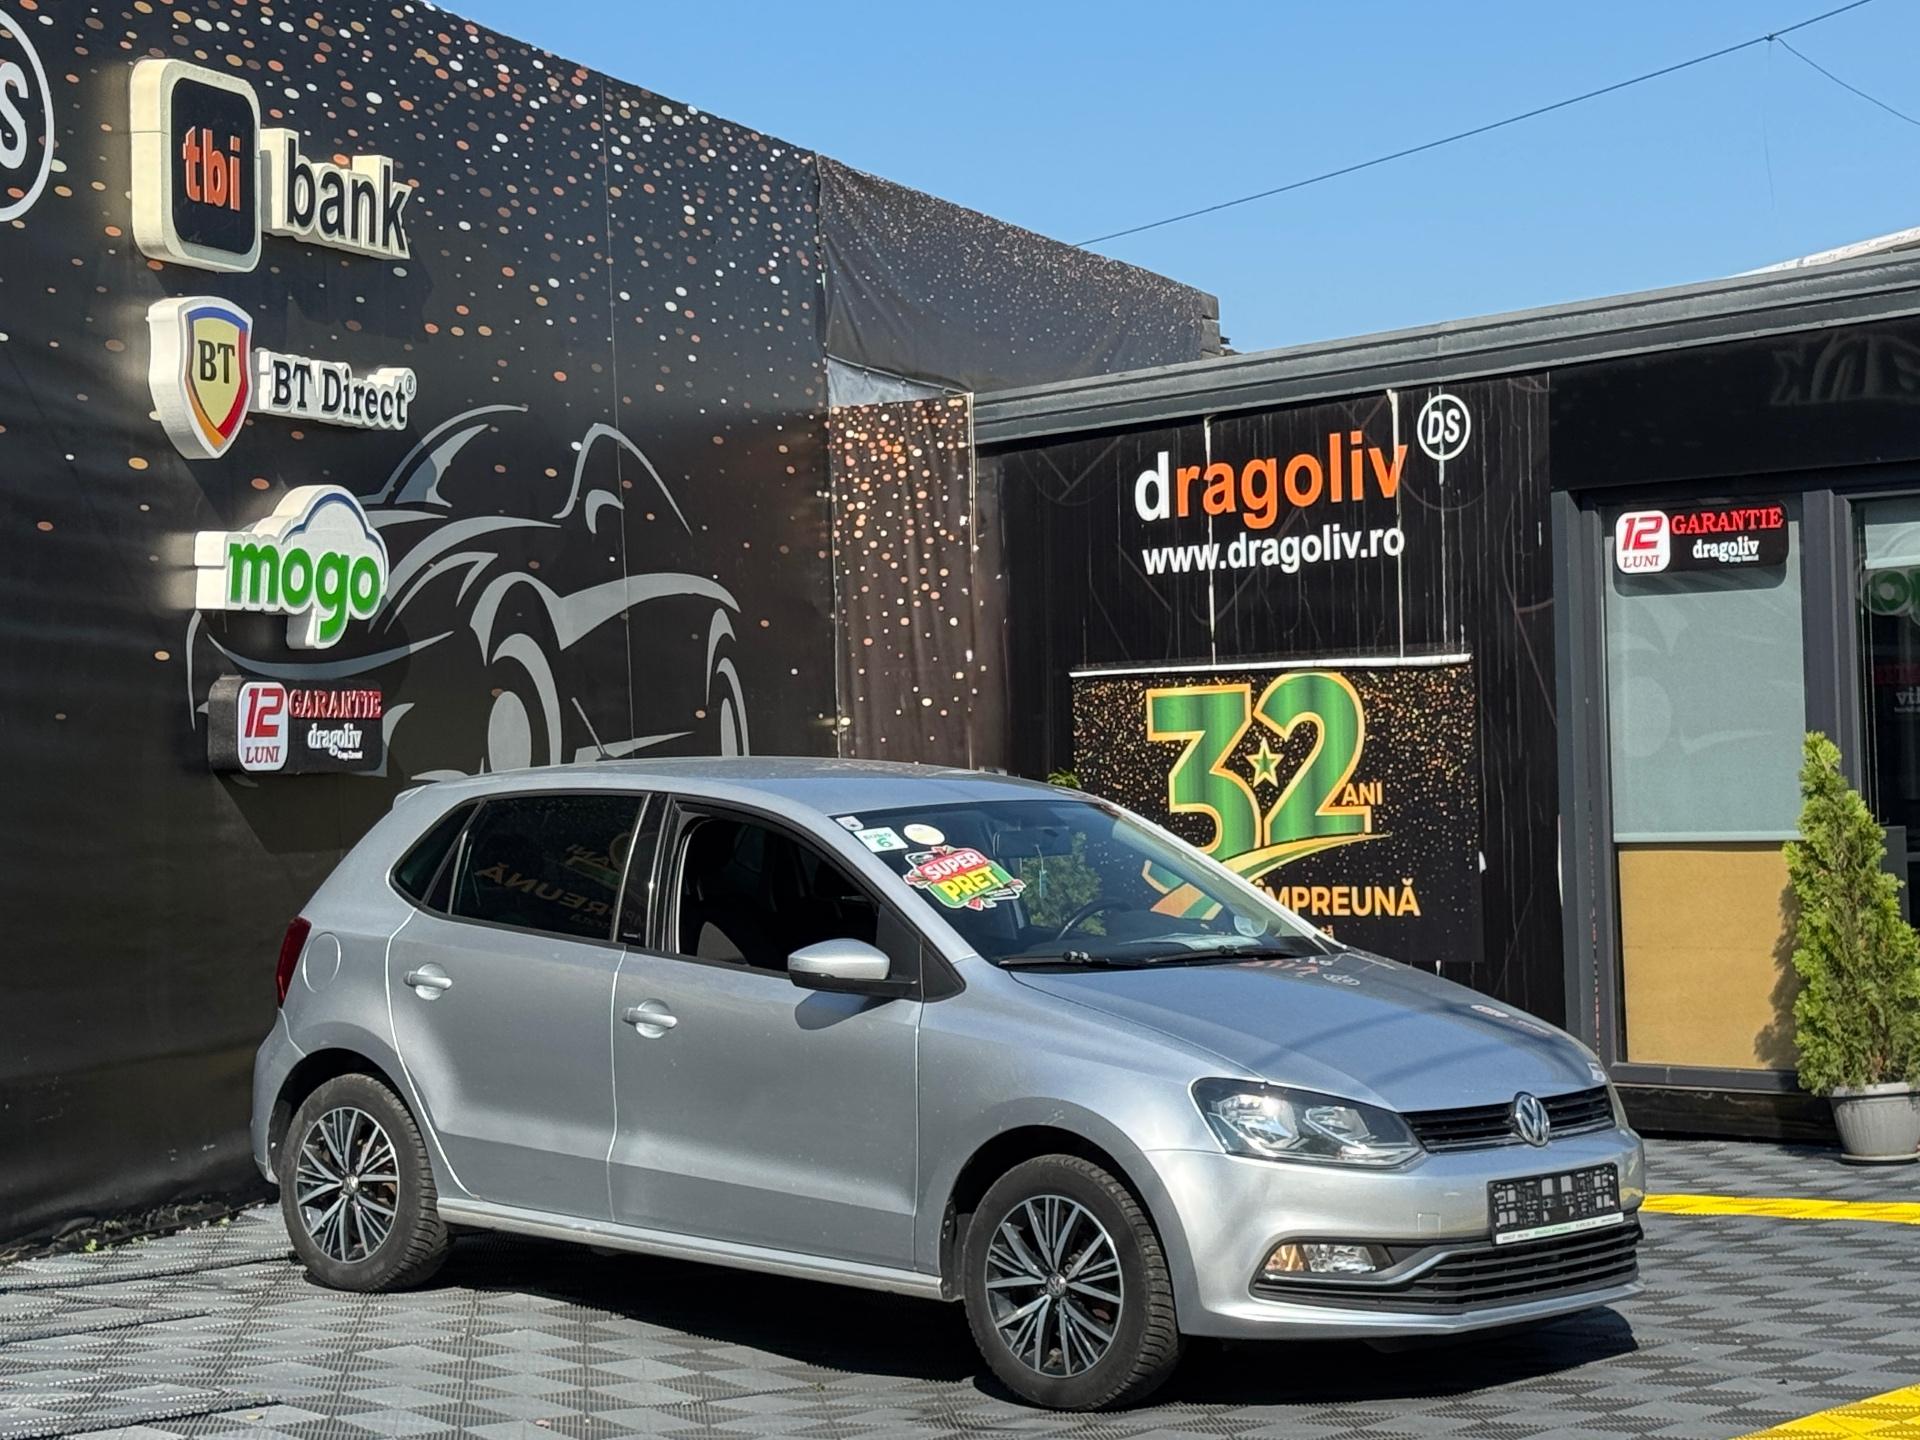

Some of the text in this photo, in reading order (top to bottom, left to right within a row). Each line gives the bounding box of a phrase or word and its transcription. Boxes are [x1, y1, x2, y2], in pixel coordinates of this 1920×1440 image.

[183, 126, 408, 252] tbi bank
[199, 339, 236, 385] BT
[271, 359, 314, 409] BT
[1426, 408, 1461, 445] DS
[1134, 430, 1408, 530] dragoliv
[1622, 516, 1663, 551] 12
[1671, 507, 1784, 535] GARANTIE
[1142, 522, 1406, 575] www.dragoliv.ro
[1623, 555, 1661, 569] LUNI
[1692, 536, 1760, 563] dragoliv
[228, 541, 382, 642] mogo
[244, 688, 285, 738] 12
[288, 689, 383, 720] GARANTIE
[244, 745, 280, 765] LUNI
[307, 722, 364, 757] dragoliv
[1144, 670, 1372, 868] 32
[1341, 781, 1383, 806] ANI
[924, 851, 982, 881] SUPER
